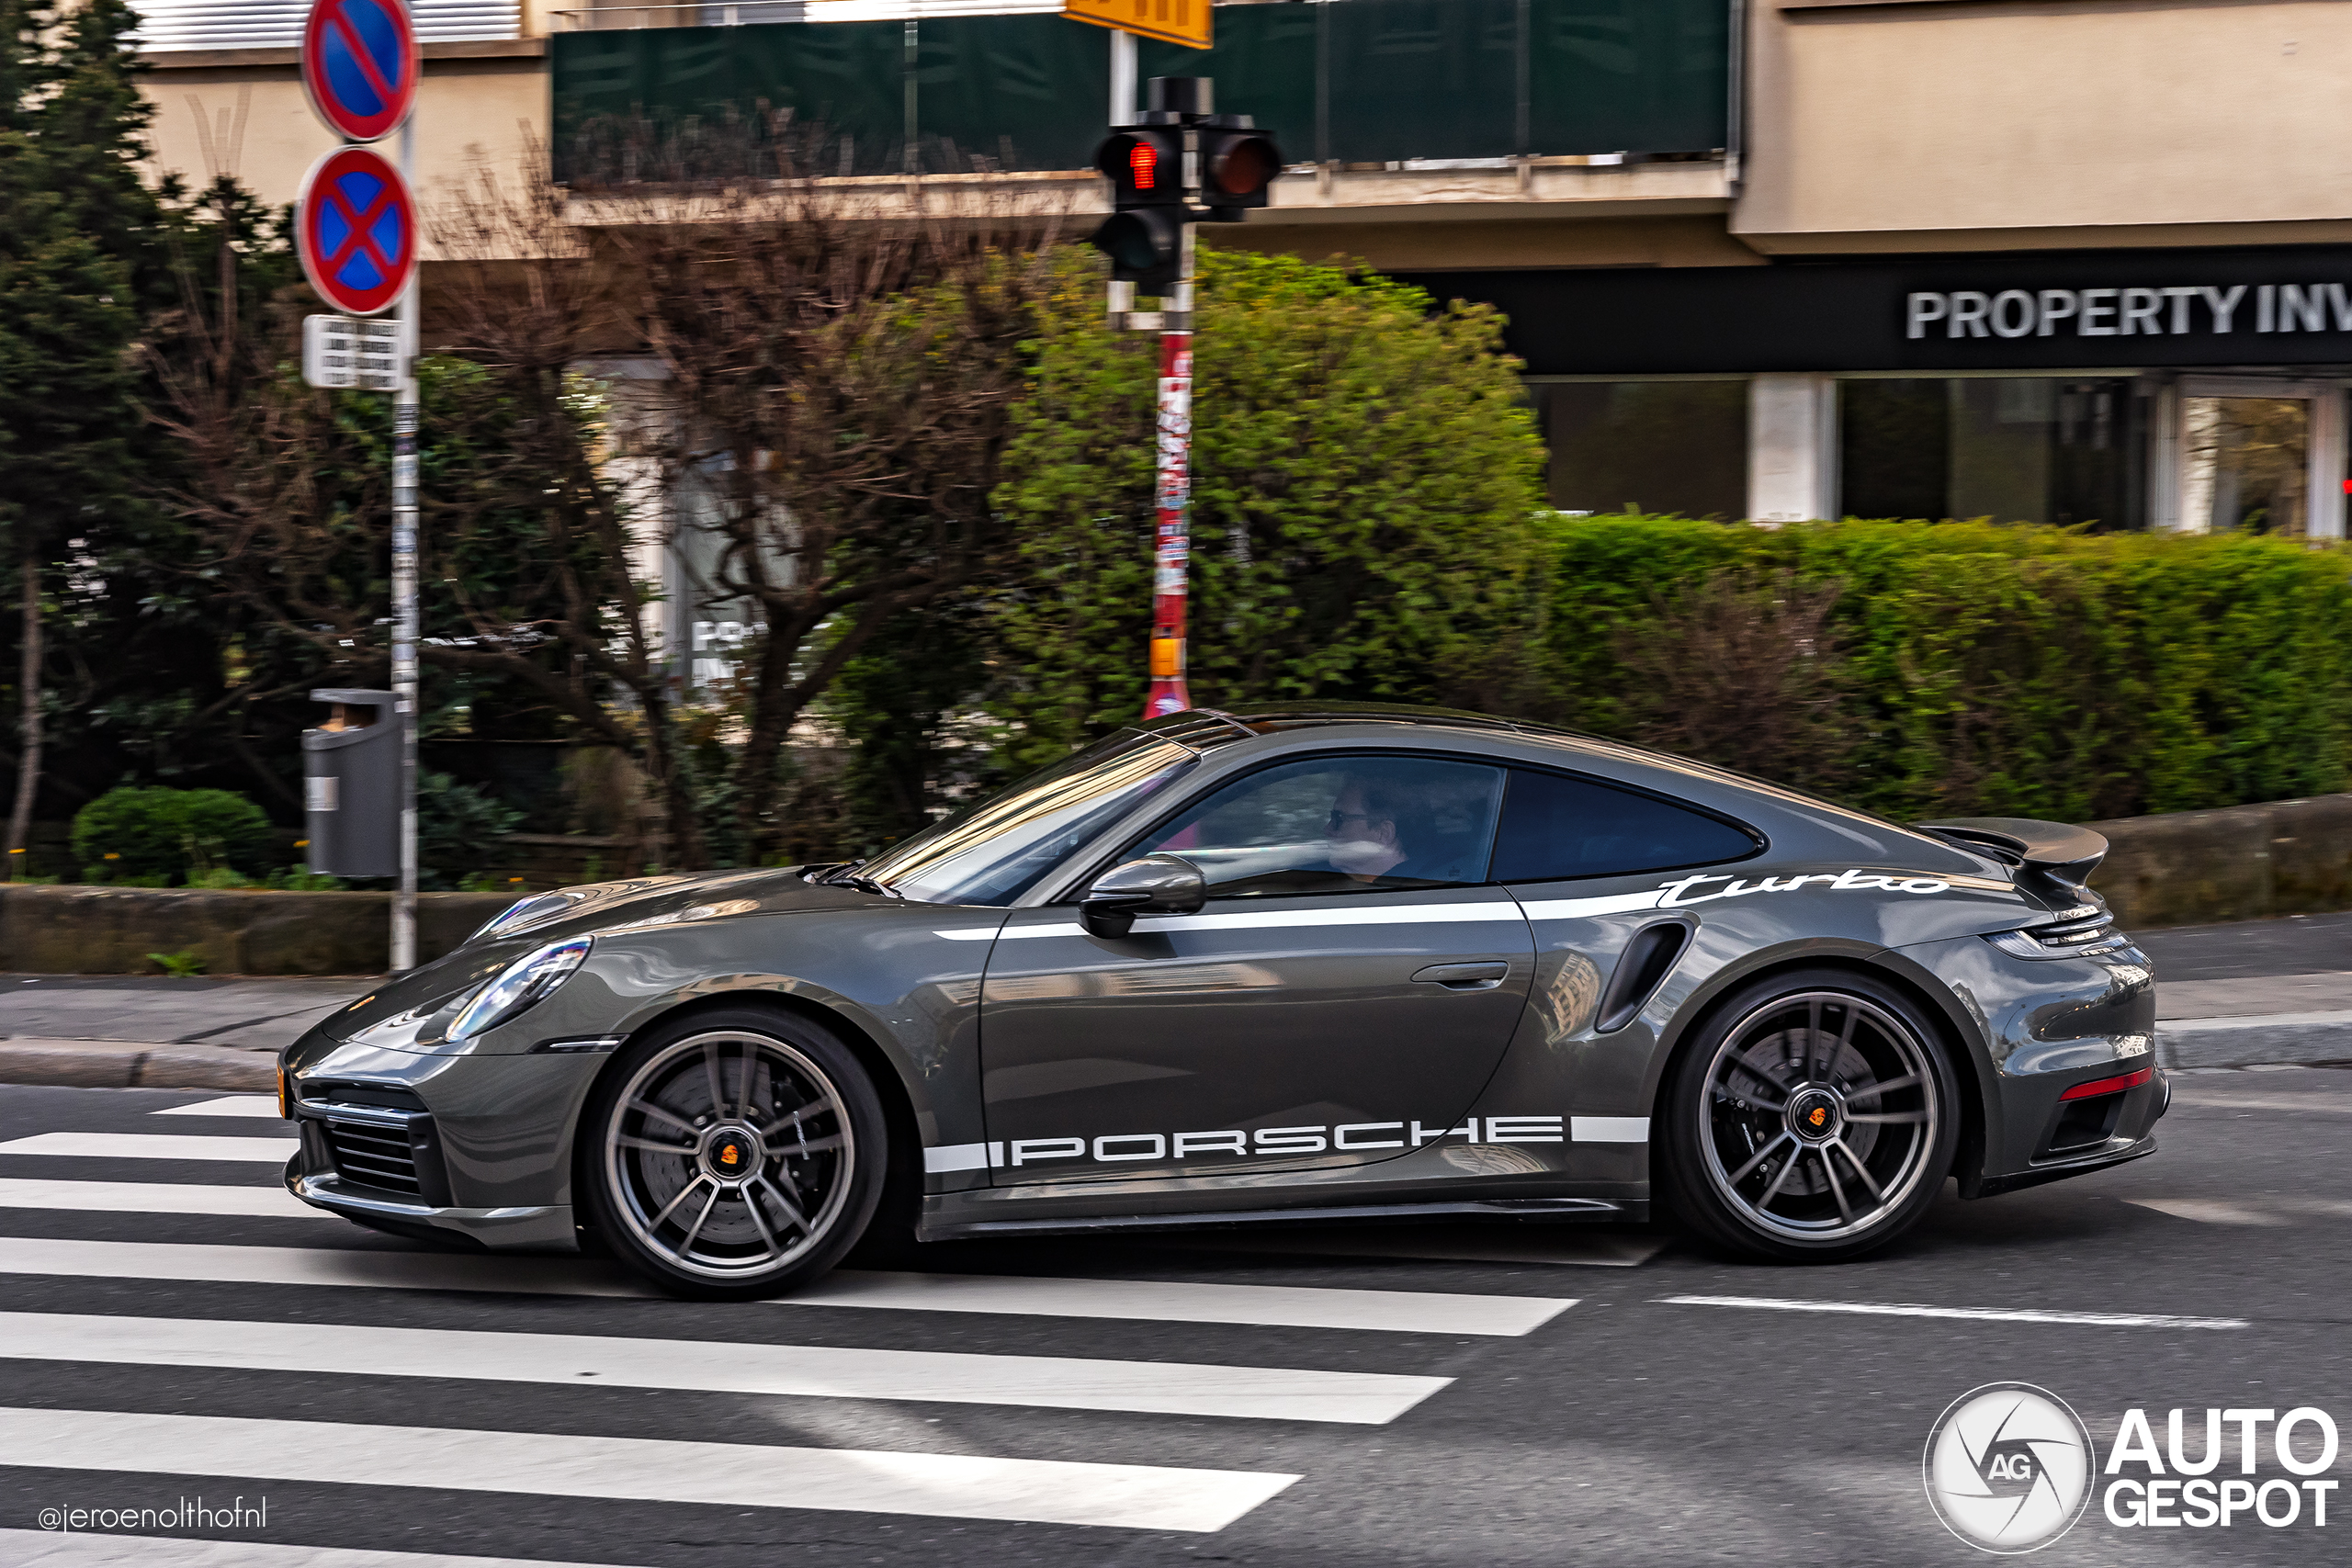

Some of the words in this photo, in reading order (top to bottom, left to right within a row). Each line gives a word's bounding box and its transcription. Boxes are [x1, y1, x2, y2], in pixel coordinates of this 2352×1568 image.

[1906, 284, 2248, 339] PROPERTY
[1656, 869, 1951, 909] turbo
[1011, 1116, 1564, 1167] PORSCHE
